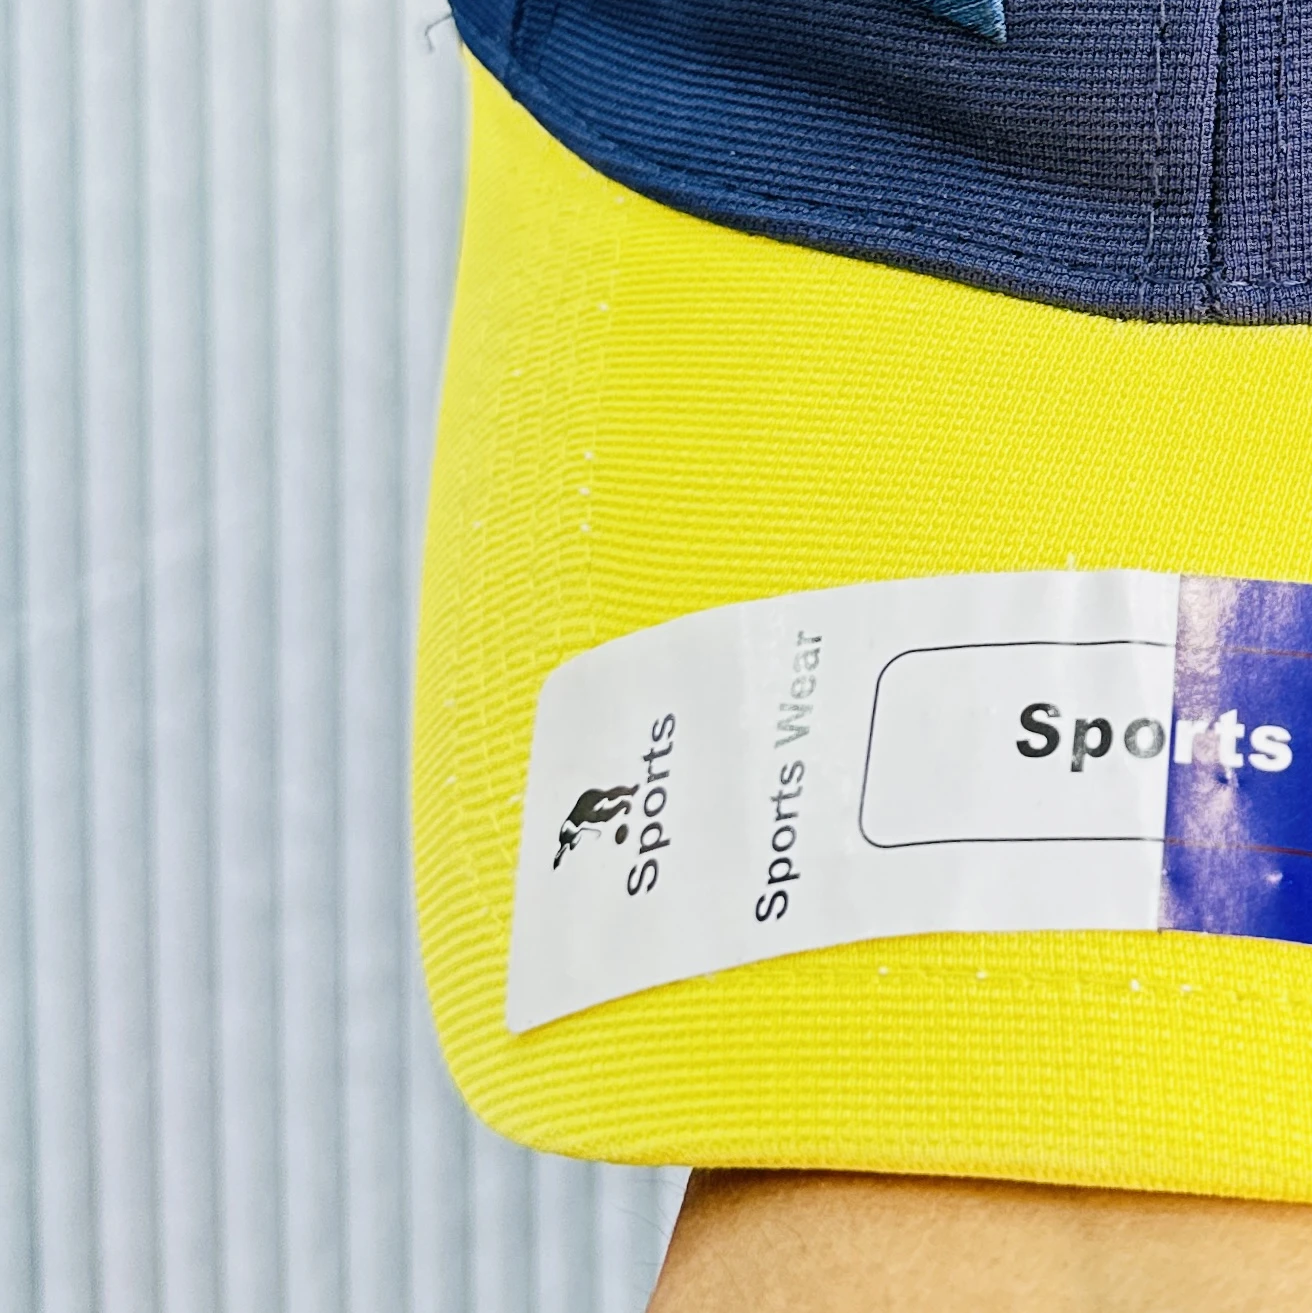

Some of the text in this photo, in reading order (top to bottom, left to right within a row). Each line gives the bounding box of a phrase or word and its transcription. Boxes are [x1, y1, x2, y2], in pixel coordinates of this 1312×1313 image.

[627, 712, 676, 897] Sports
[755, 630, 823, 922] Sports Wear
[1015, 701, 1294, 773] Sports
